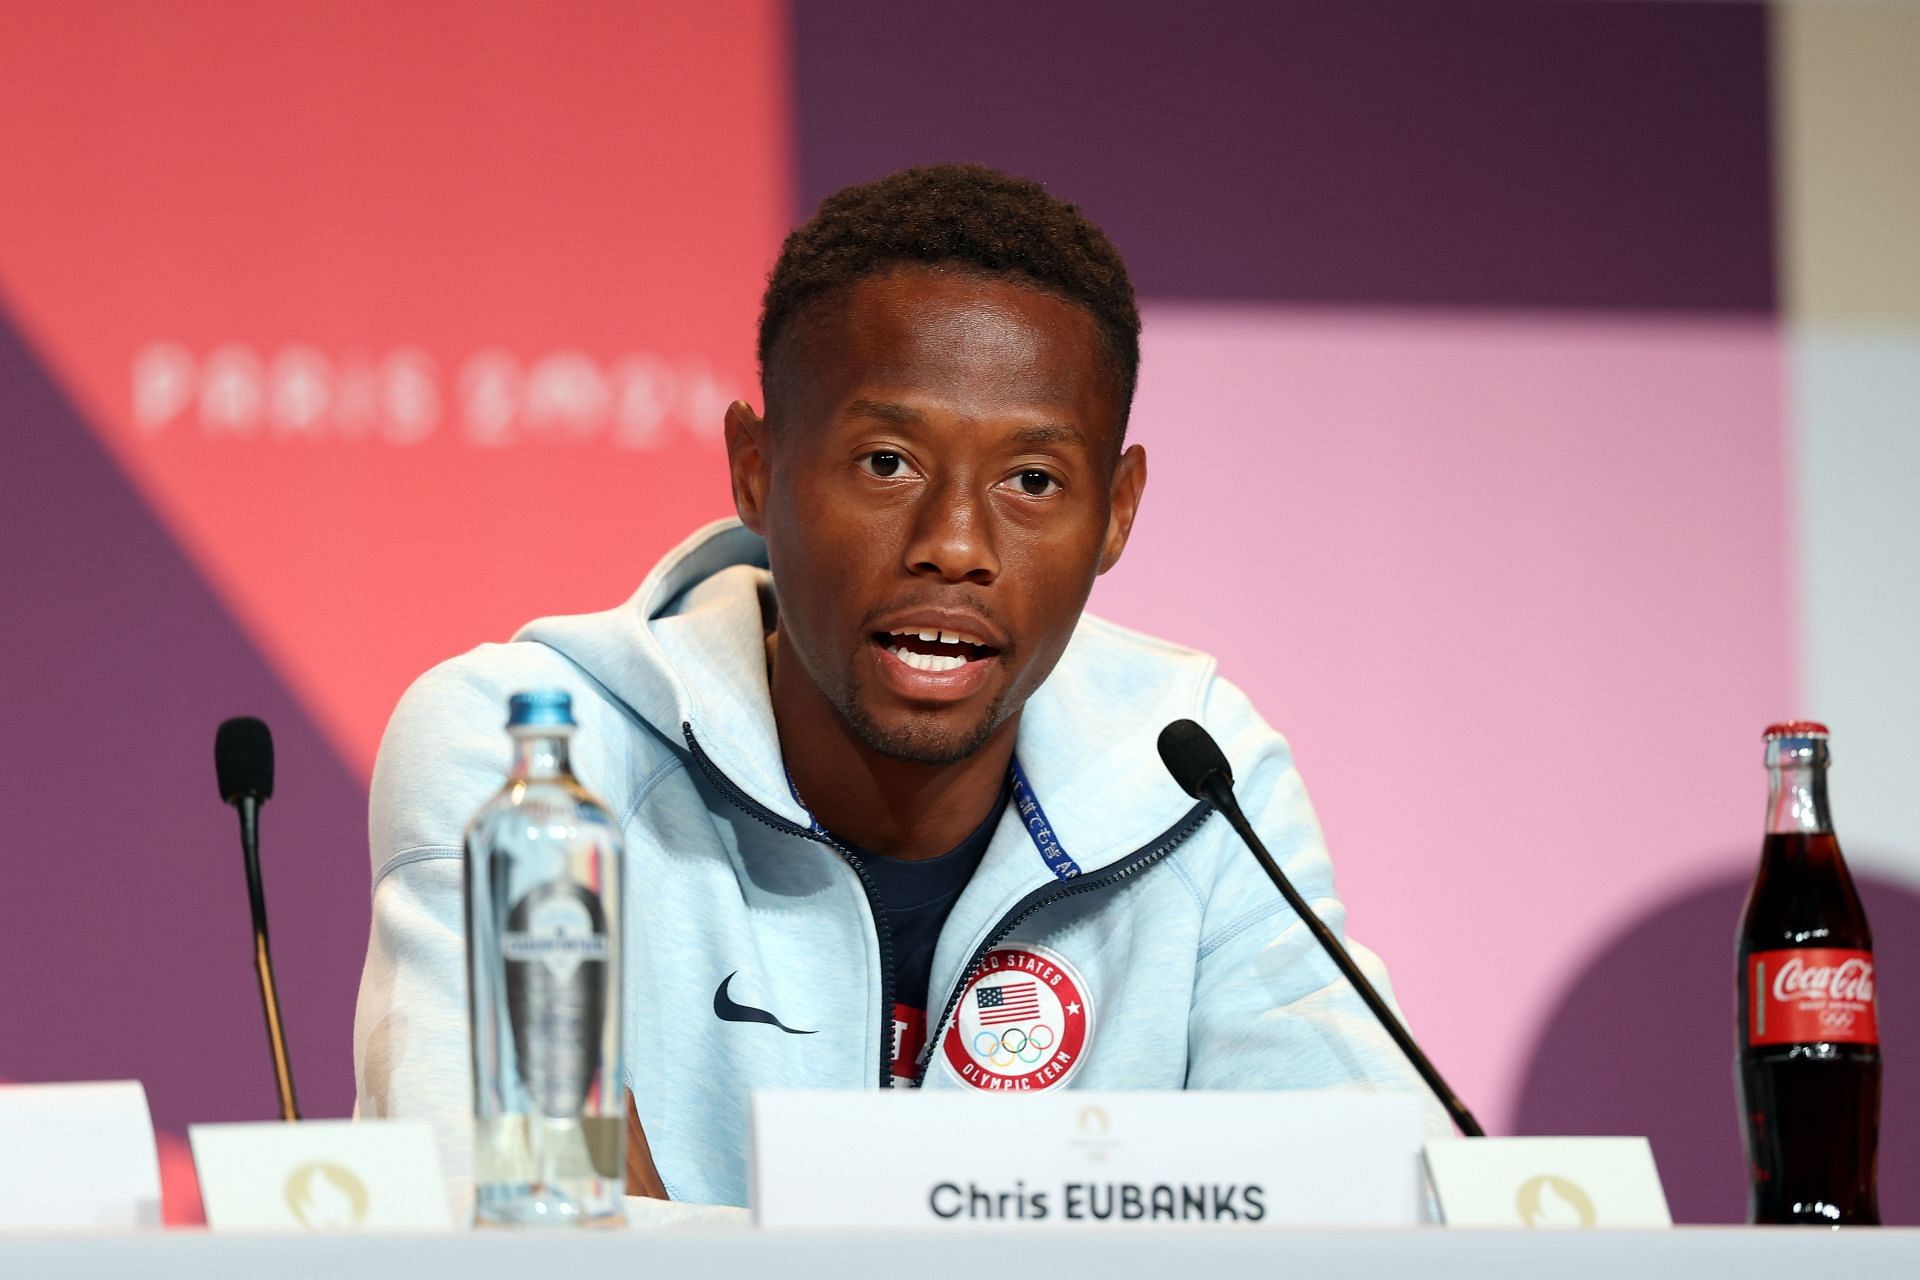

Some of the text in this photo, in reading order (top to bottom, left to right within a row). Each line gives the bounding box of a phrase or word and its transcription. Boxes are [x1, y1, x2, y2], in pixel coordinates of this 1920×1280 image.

[131, 342, 440, 446] PARIS
[1007, 954, 1063, 986] STATES
[962, 1050, 1071, 1091] OLYMPIC TEAM
[929, 1181, 1266, 1221] Chris EUBANKS
